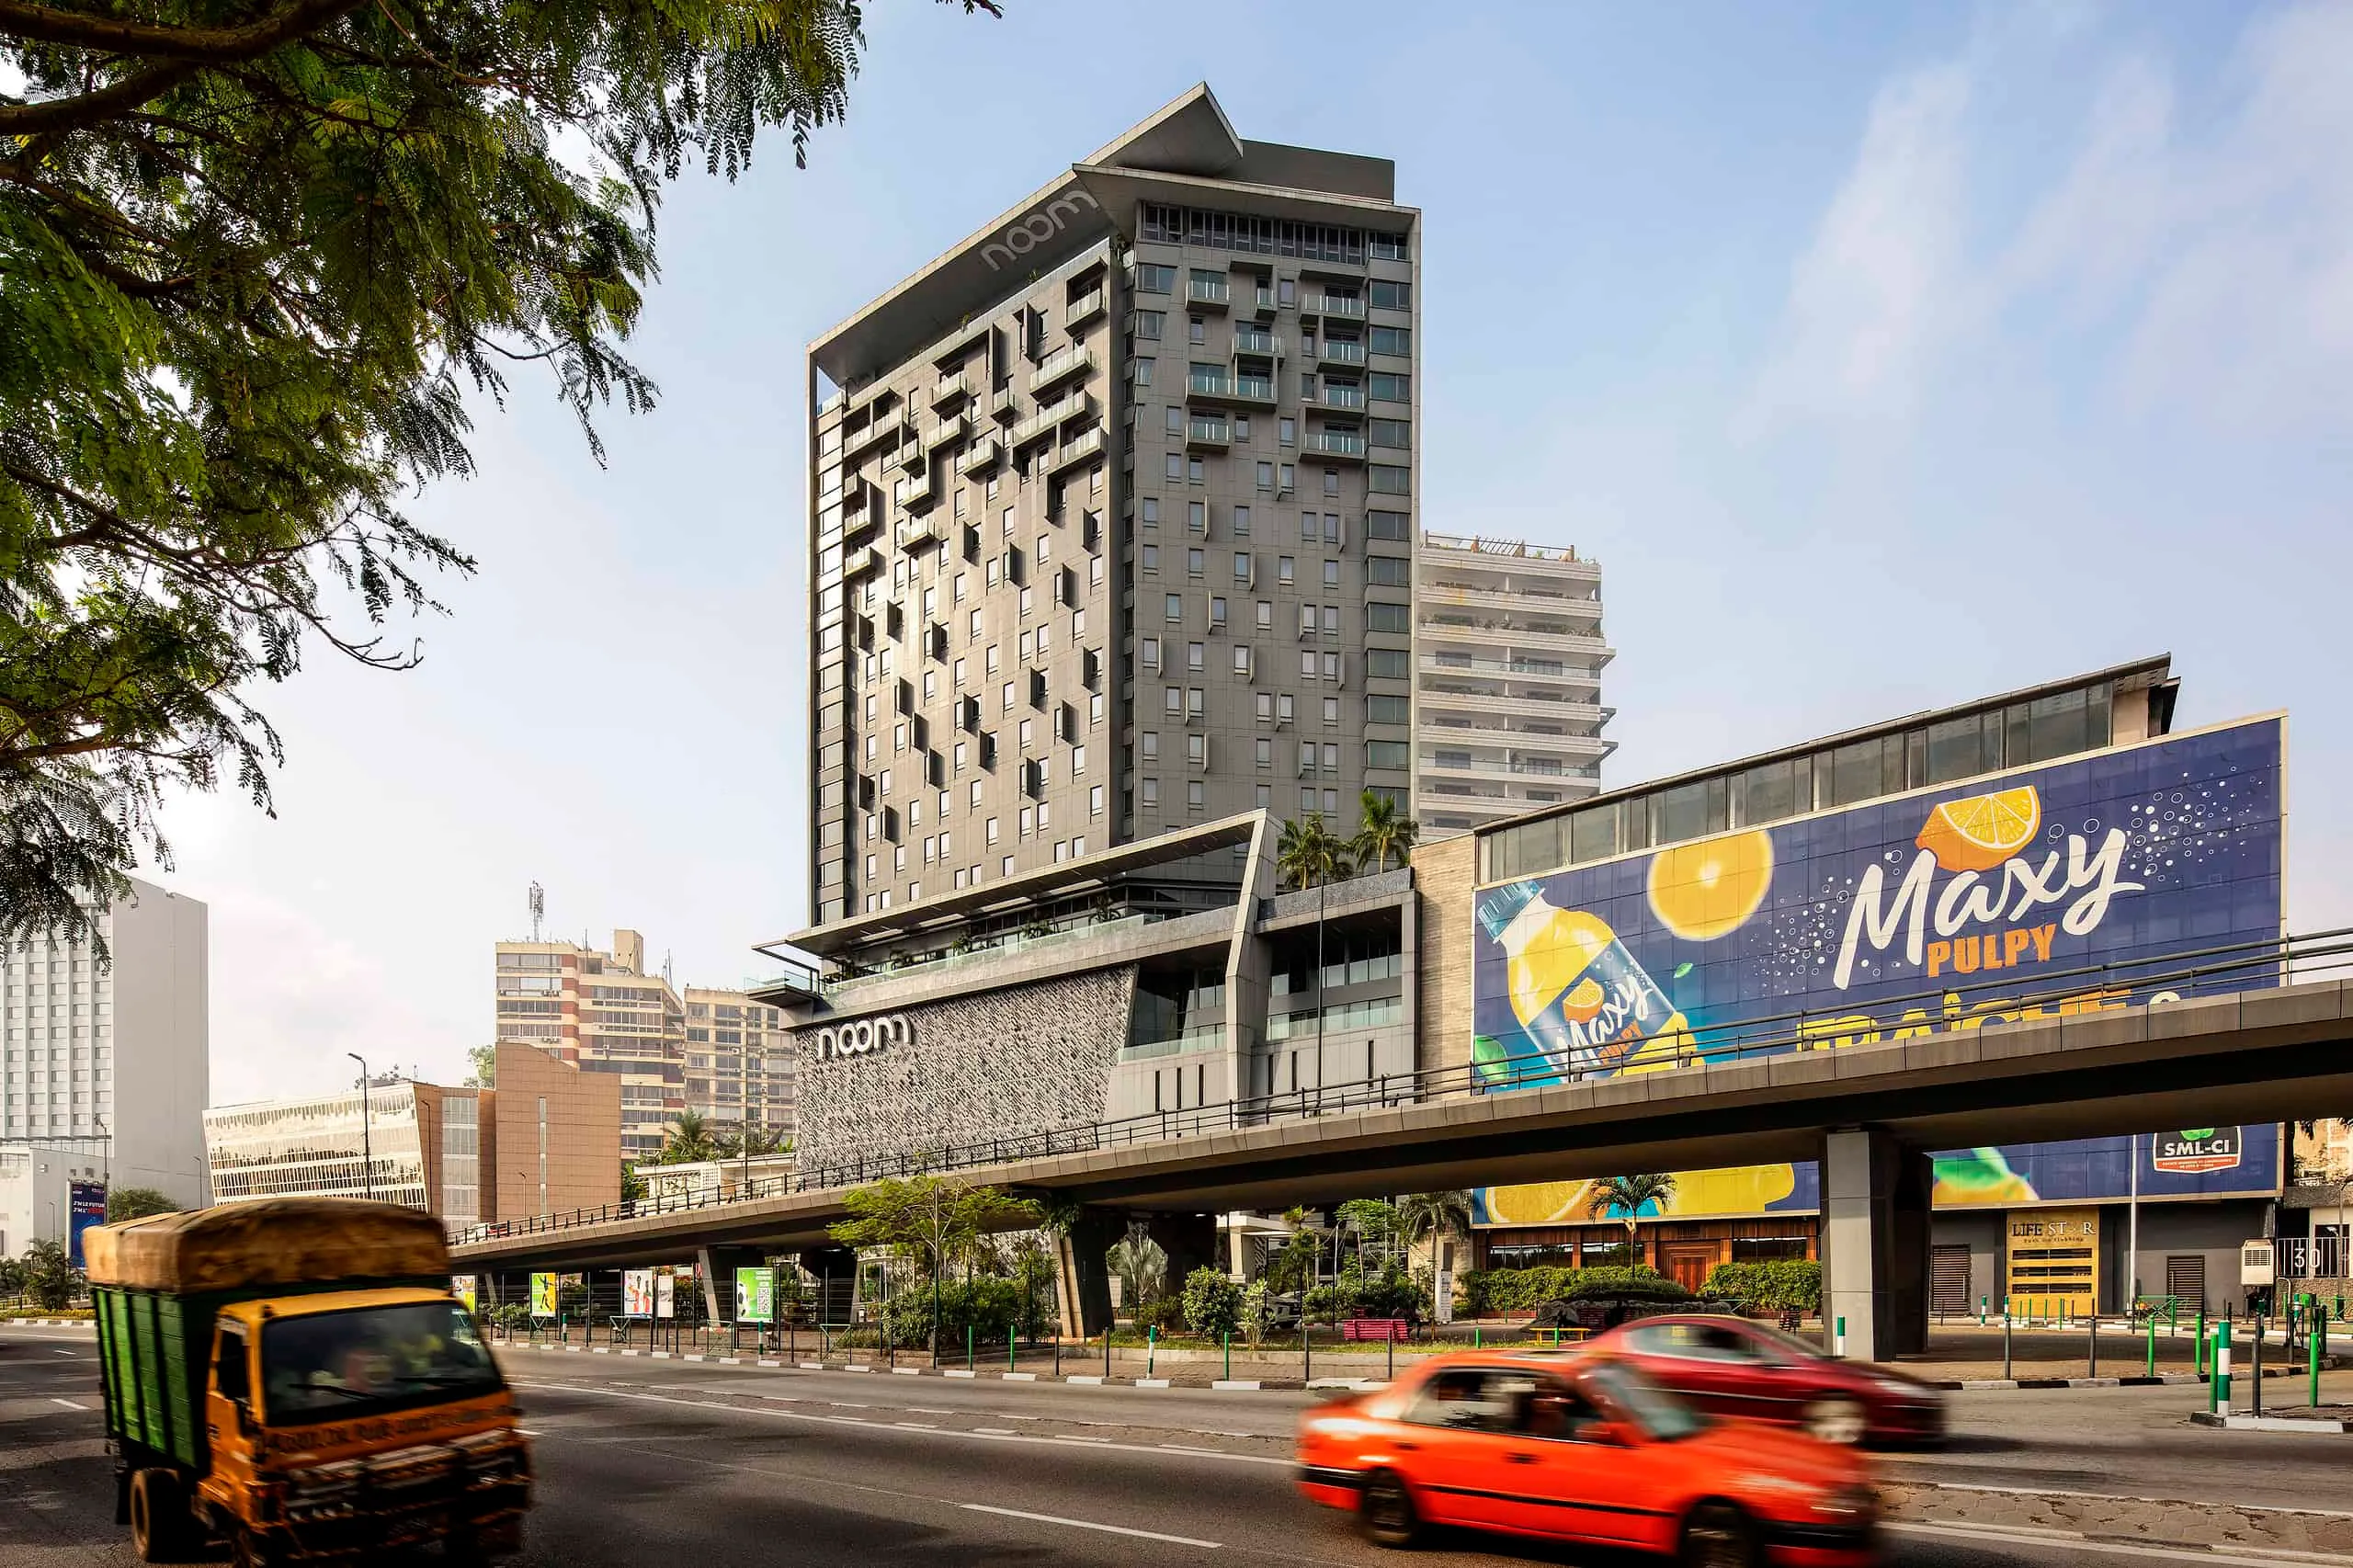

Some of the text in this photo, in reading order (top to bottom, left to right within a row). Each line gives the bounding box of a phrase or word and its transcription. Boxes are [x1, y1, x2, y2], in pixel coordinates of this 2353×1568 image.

[980, 189, 1099, 271] noom
[1833, 828, 2146, 991] Maxy
[1927, 924, 2058, 978] PULPY
[818, 1014, 911, 1059] noom
[2164, 1139, 2230, 1156] SML-CI
[2012, 1221, 2043, 1237] LIFE
